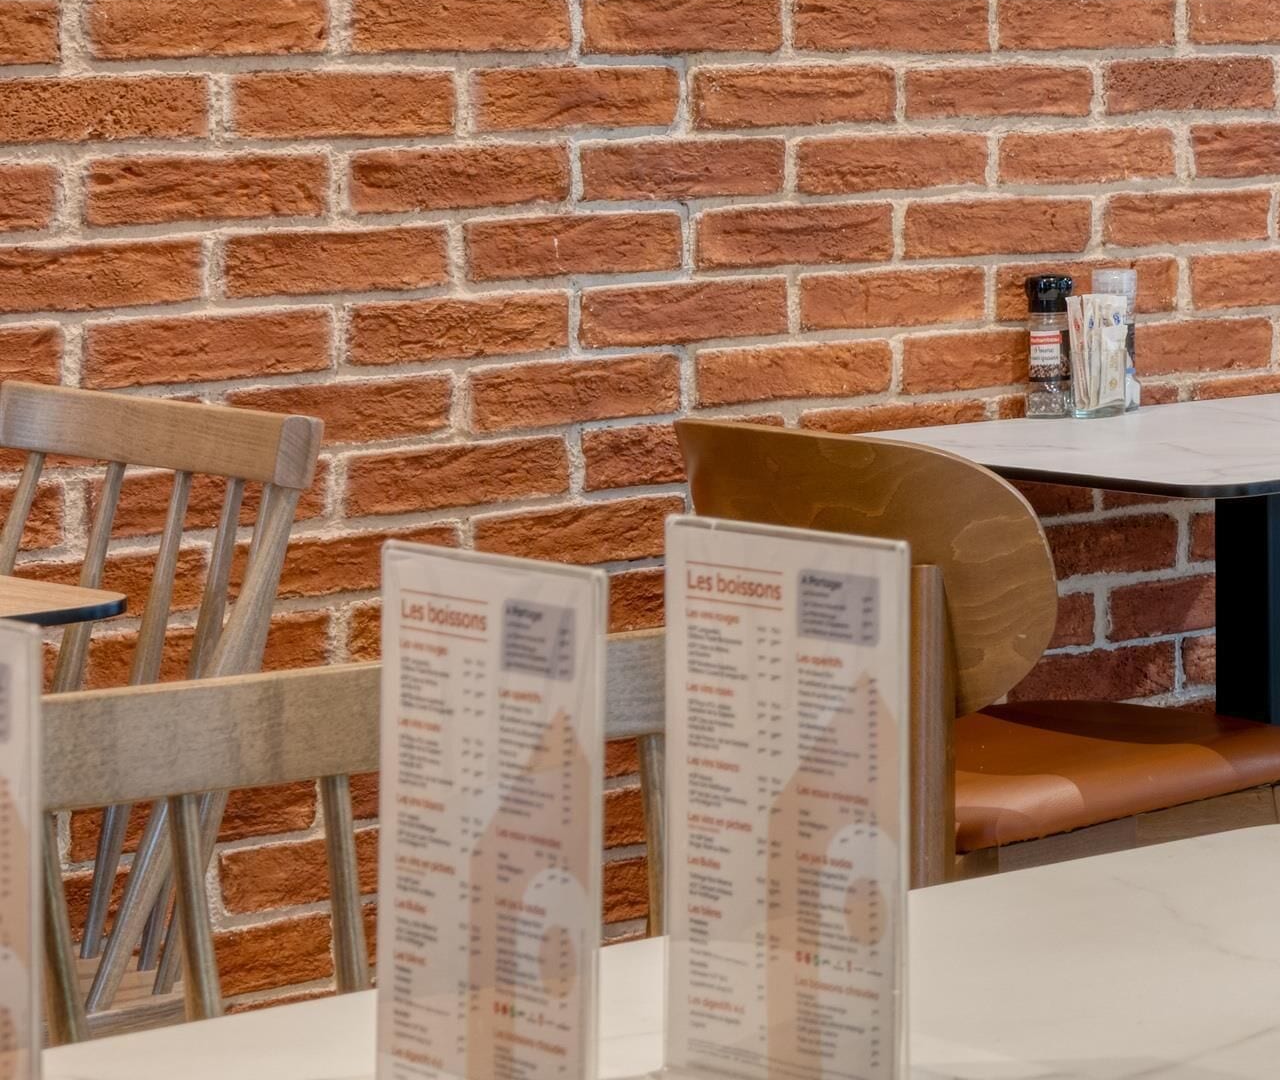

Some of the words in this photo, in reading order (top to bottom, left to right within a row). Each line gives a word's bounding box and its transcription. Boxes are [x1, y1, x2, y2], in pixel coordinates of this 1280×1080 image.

[686, 570, 713, 592] Les
[717, 572, 782, 601] boissons
[401, 599, 424, 620] Les
[428, 602, 487, 631] boissons
